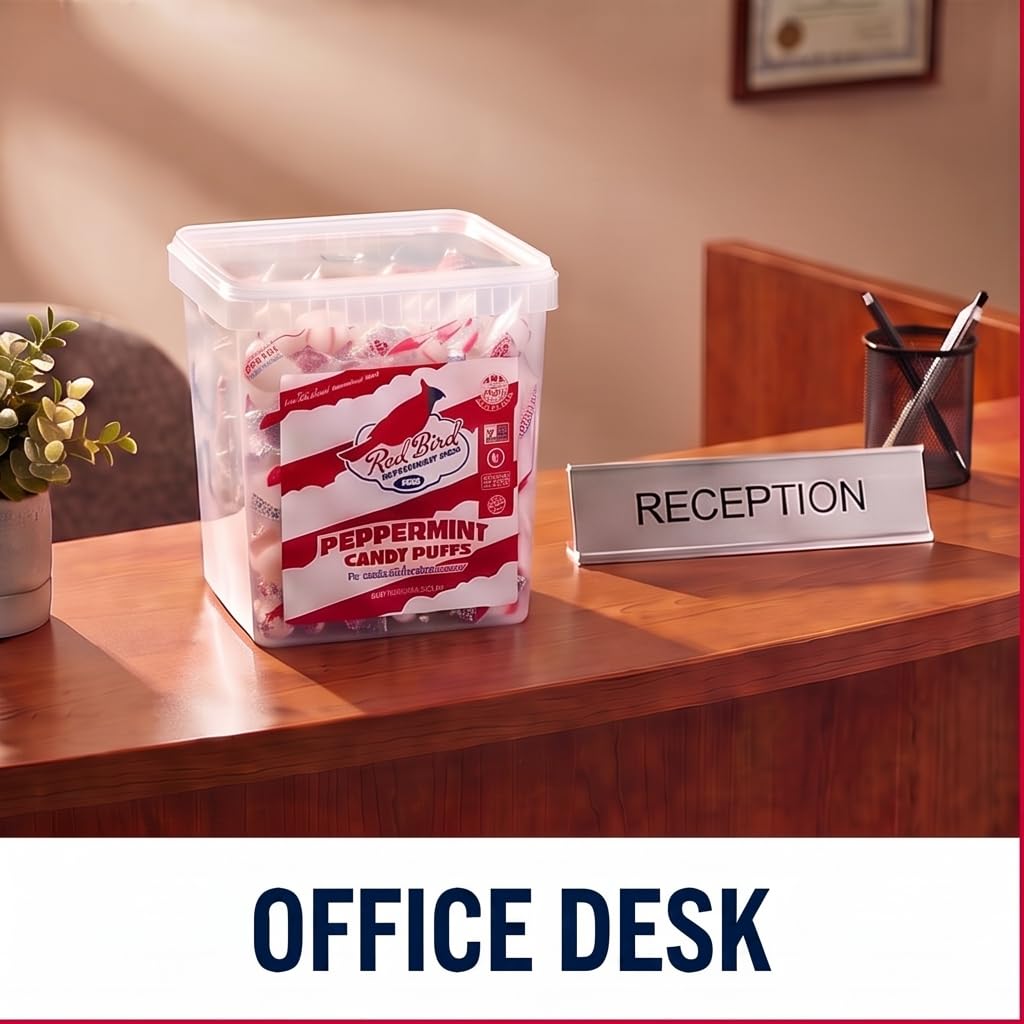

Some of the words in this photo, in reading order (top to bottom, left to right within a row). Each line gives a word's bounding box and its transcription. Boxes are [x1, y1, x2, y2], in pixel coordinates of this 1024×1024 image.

[365, 438, 410, 476] Red
[412, 419, 462, 459] Bird
[635, 479, 866, 525] RECEPTION
[320, 519, 489, 557] PEPPERMINT
[344, 547, 409, 567] CANDY
[412, 543, 472, 561] PUFFS
